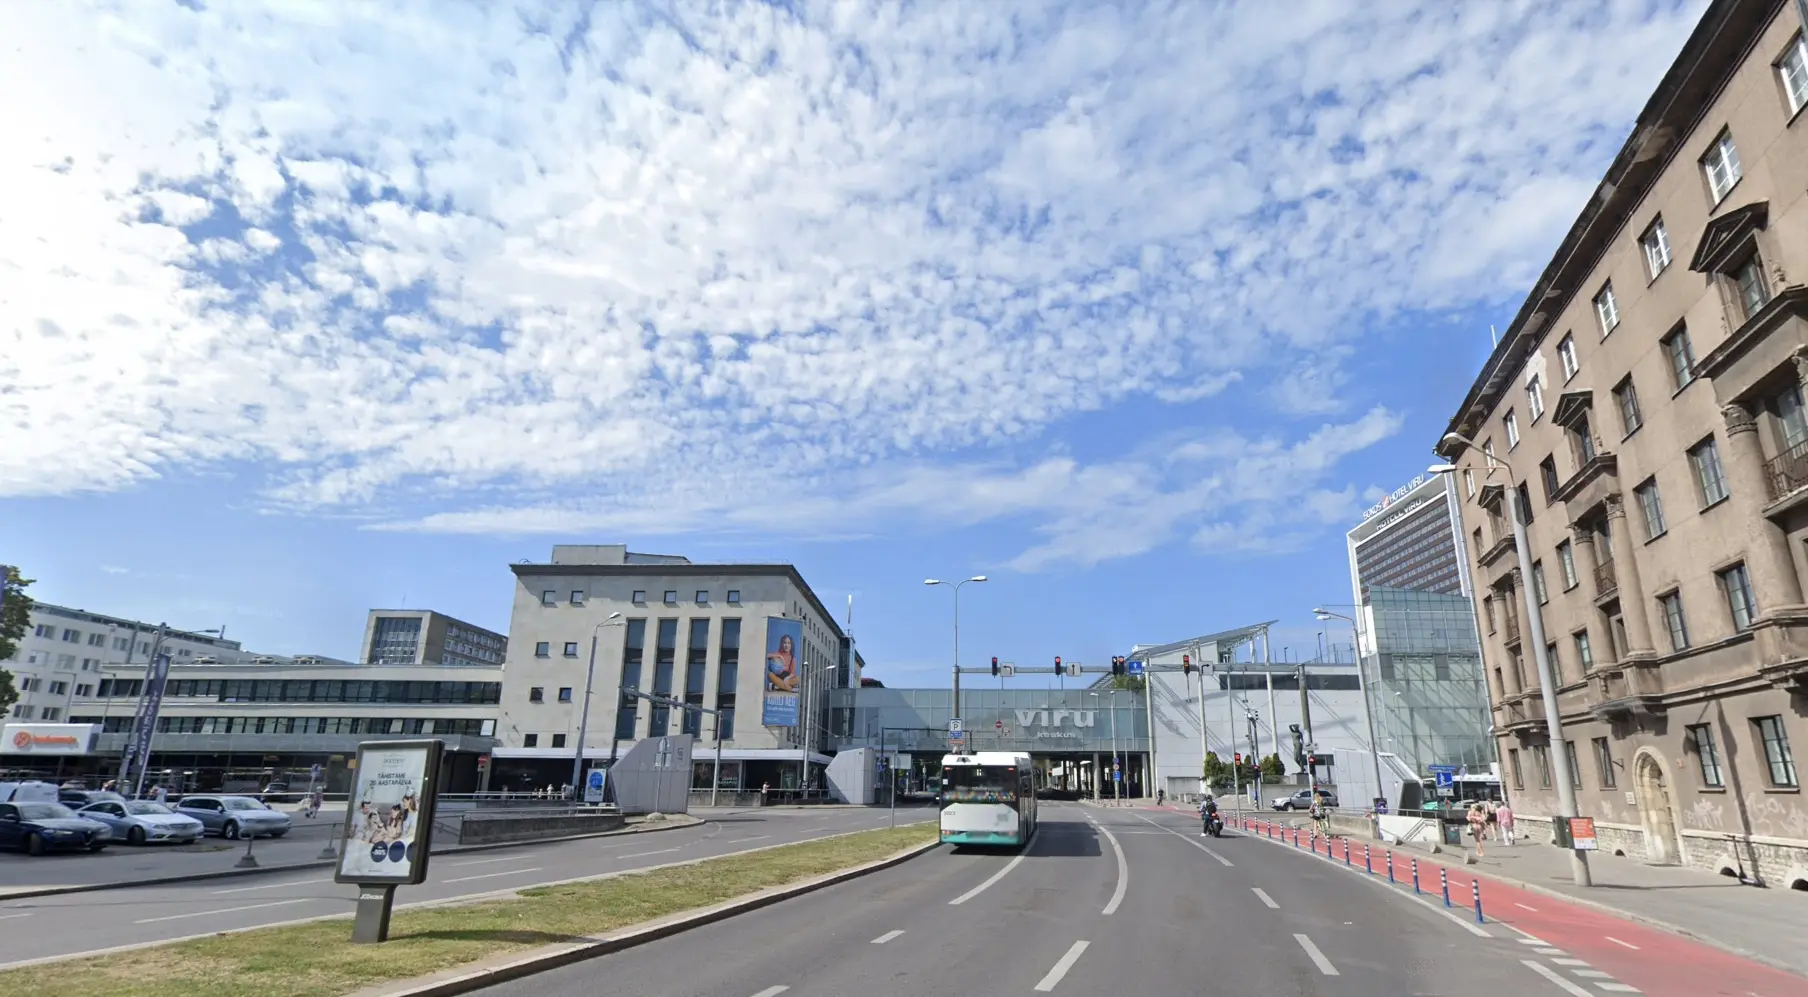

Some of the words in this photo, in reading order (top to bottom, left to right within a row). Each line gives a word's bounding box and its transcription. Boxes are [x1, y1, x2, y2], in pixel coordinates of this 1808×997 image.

[1363, 502, 1382, 520] SOKOS
[1389, 485, 1408, 503] HOTEL
[1408, 474, 1424, 490] VIRU
[1404, 498, 1422, 513] VIRU
[1014, 704, 1098, 728] viru
